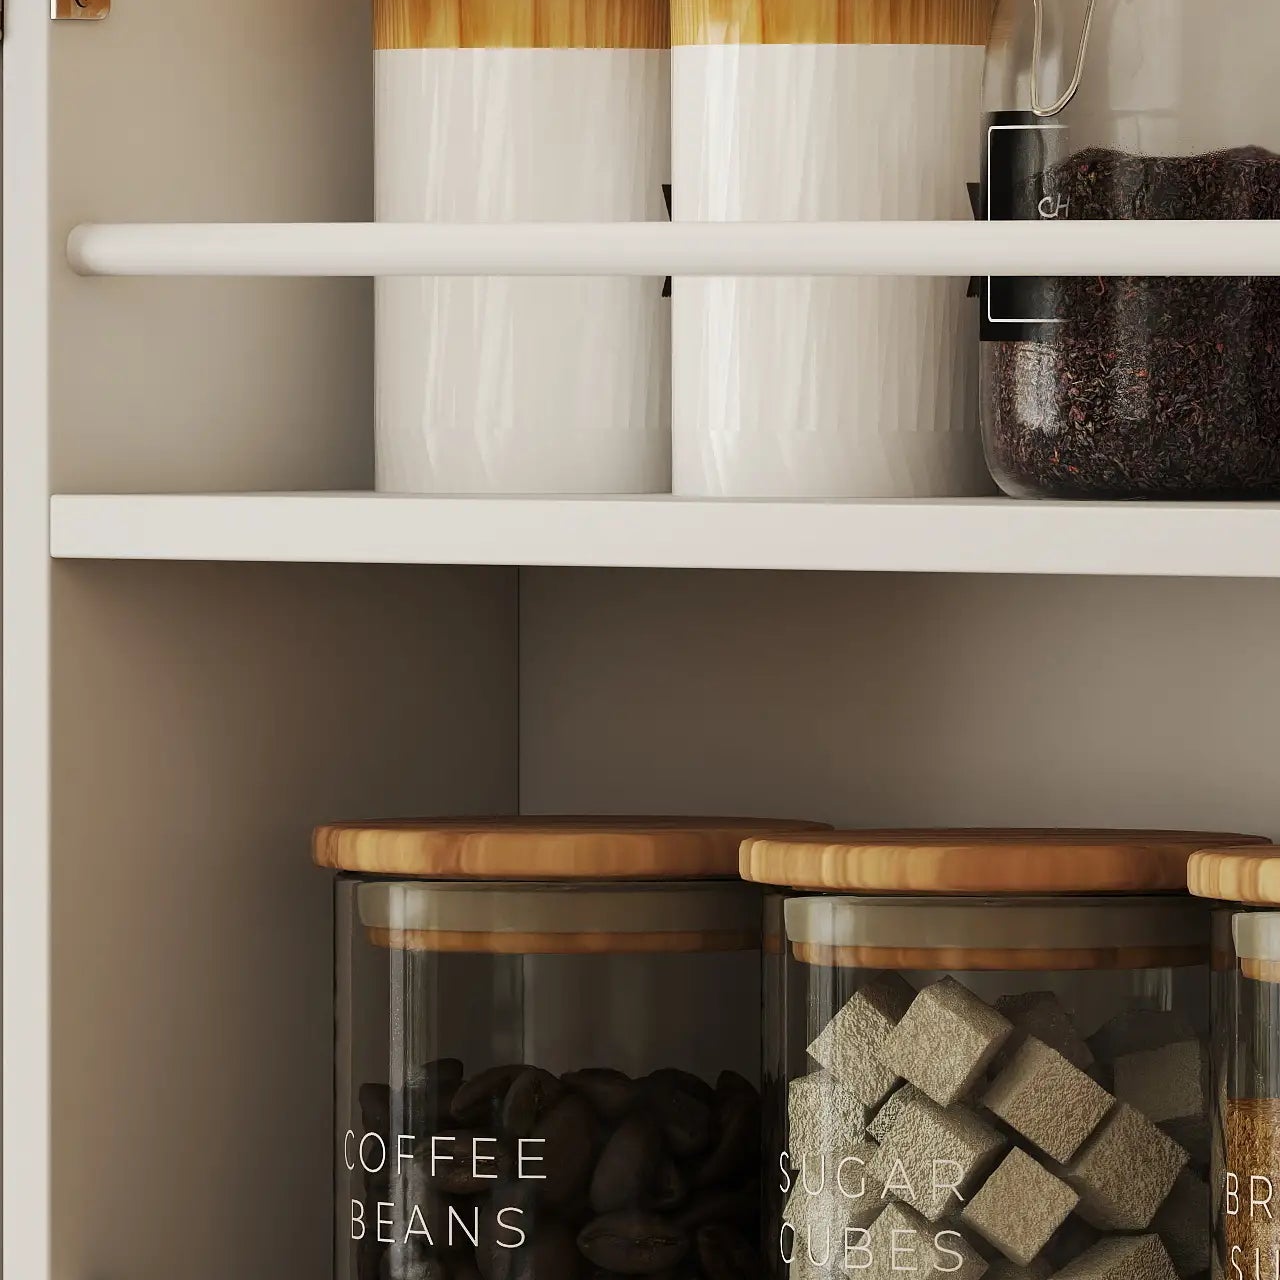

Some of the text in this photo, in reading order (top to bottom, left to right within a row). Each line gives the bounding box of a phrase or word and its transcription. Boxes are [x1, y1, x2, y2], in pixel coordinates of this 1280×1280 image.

[344, 1129, 547, 1179] COFFEE
[779, 1151, 964, 1201] SUGAR
[351, 1199, 526, 1248] BEANS
[780, 1222, 963, 1272] CUBES
